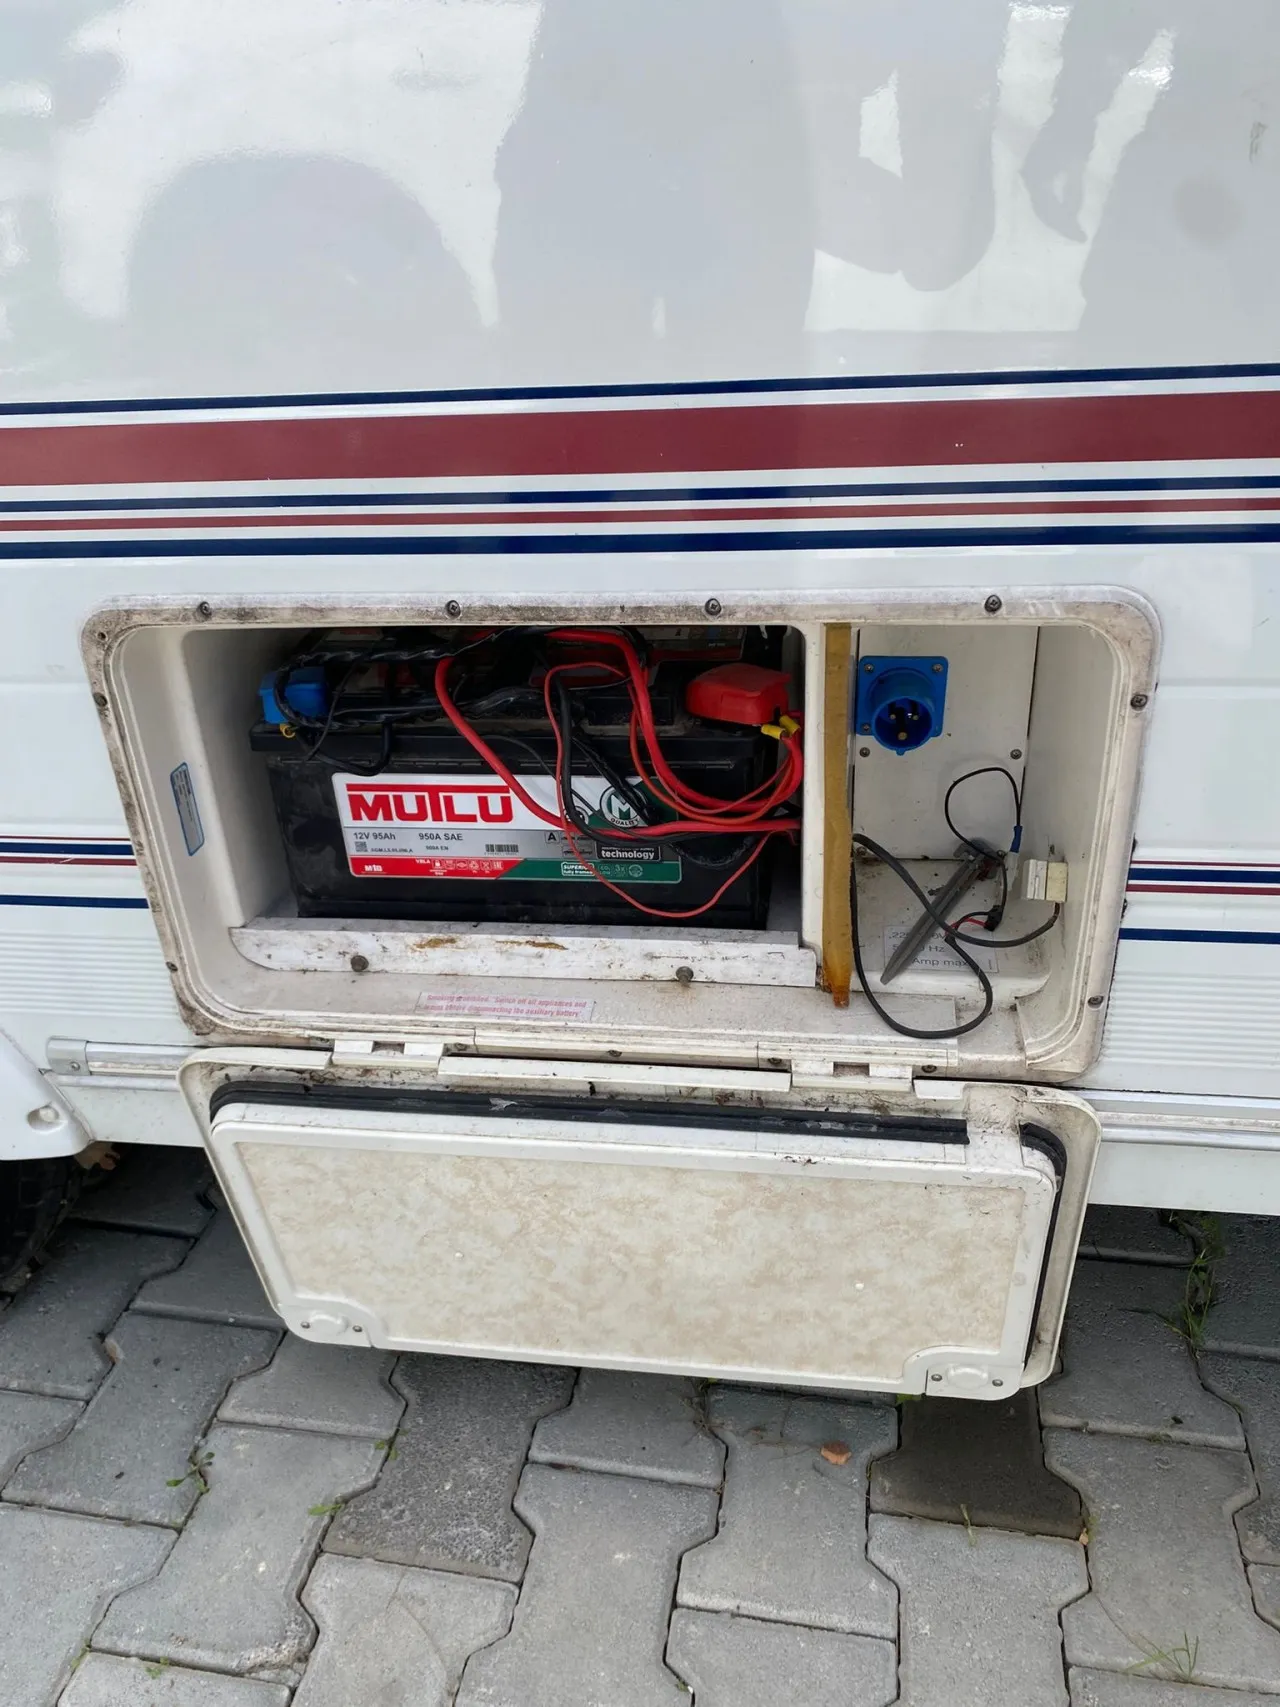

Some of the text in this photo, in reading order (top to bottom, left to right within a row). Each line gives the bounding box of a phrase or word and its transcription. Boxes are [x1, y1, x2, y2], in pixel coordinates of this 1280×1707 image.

[346, 784, 513, 822] MUTLU
[354, 832, 396, 841] 12V 95Ah
[419, 833, 441, 841] 950A
[601, 850, 655, 859] technology
[912, 957, 940, 967] Amp
[538, 999, 573, 1008] appliances
[525, 1008, 554, 1017] auxiliary
[556, 1010, 580, 1018] battery
